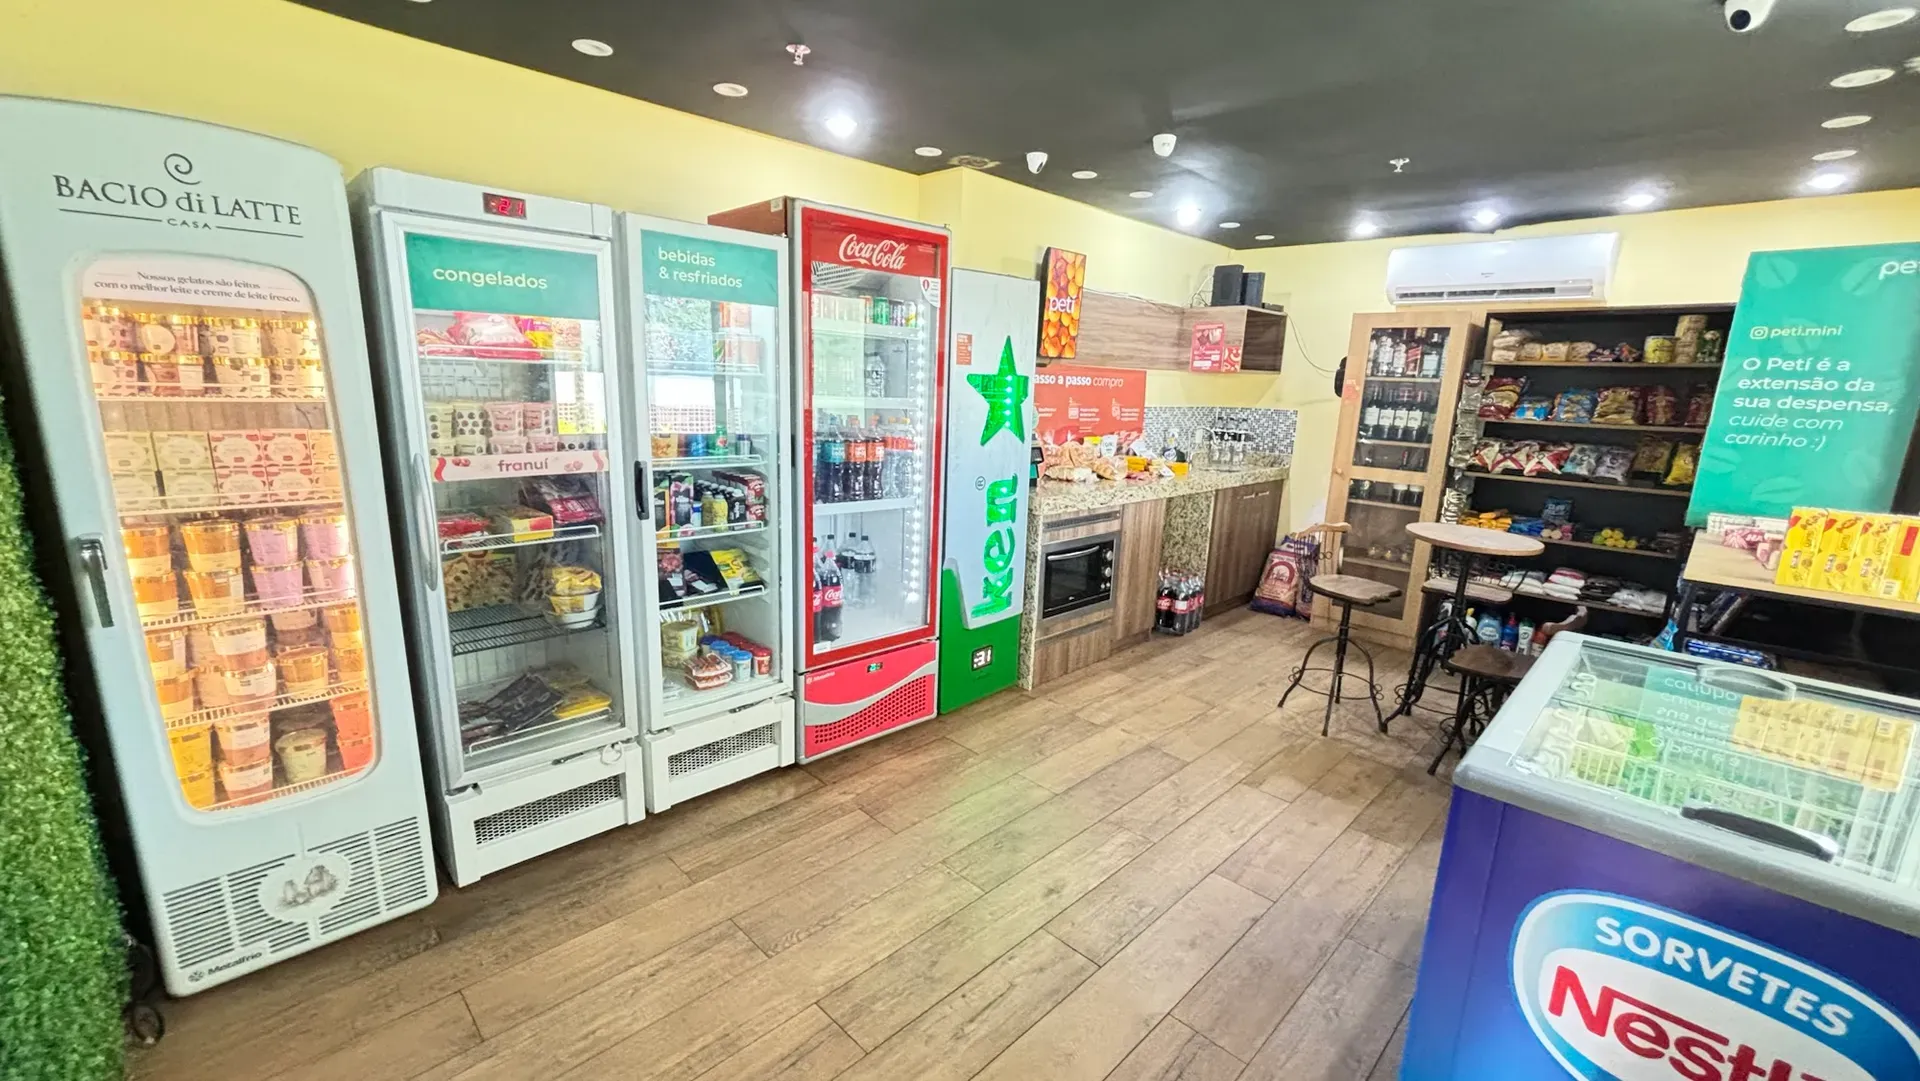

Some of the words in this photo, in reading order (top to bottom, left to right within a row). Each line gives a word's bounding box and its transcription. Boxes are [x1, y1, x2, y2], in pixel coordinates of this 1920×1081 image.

[53, 174, 168, 209] BACIO
[175, 192, 206, 213] di
[212, 195, 303, 226] LATTE
[166, 217, 212, 231] CASA
[658, 247, 716, 268] bebidas
[838, 233, 910, 270] Coca-Cola
[137, 271, 176, 282] Nossos
[177, 276, 214, 287] gelatos
[215, 278, 233, 289] são
[234, 279, 261, 290] feitos
[432, 267, 548, 291] congelados
[659, 267, 669, 279] &
[673, 268, 743, 289] resfriados
[1878, 260, 1920, 281] pe
[94, 280, 119, 289] com
[129, 282, 168, 293] melhor
[169, 284, 193, 294] leite
[201, 288, 233, 298] creme
[233, 288, 246, 298] de
[247, 290, 268, 300] leite
[1742, 357, 1761, 371] O
[1766, 356, 1814, 372] Petí
[1816, 357, 1832, 372] é
[1836, 360, 1851, 372] a
[1033, 374, 1056, 385] asso
[1057, 375, 1064, 385] a
[1065, 375, 1092, 388] passo
[1092, 376, 1124, 389] compro
[1737, 376, 1839, 391] extensão
[1844, 377, 1875, 392] da
[1732, 396, 1771, 408] sua
[1776, 394, 1896, 415] despensa,
[1728, 413, 1789, 428] cuide
[1792, 418, 1844, 431] com
[1724, 432, 1808, 448] carinho
[497, 456, 549, 473] franuí
[1594, 917, 1854, 1037] SORVETES
